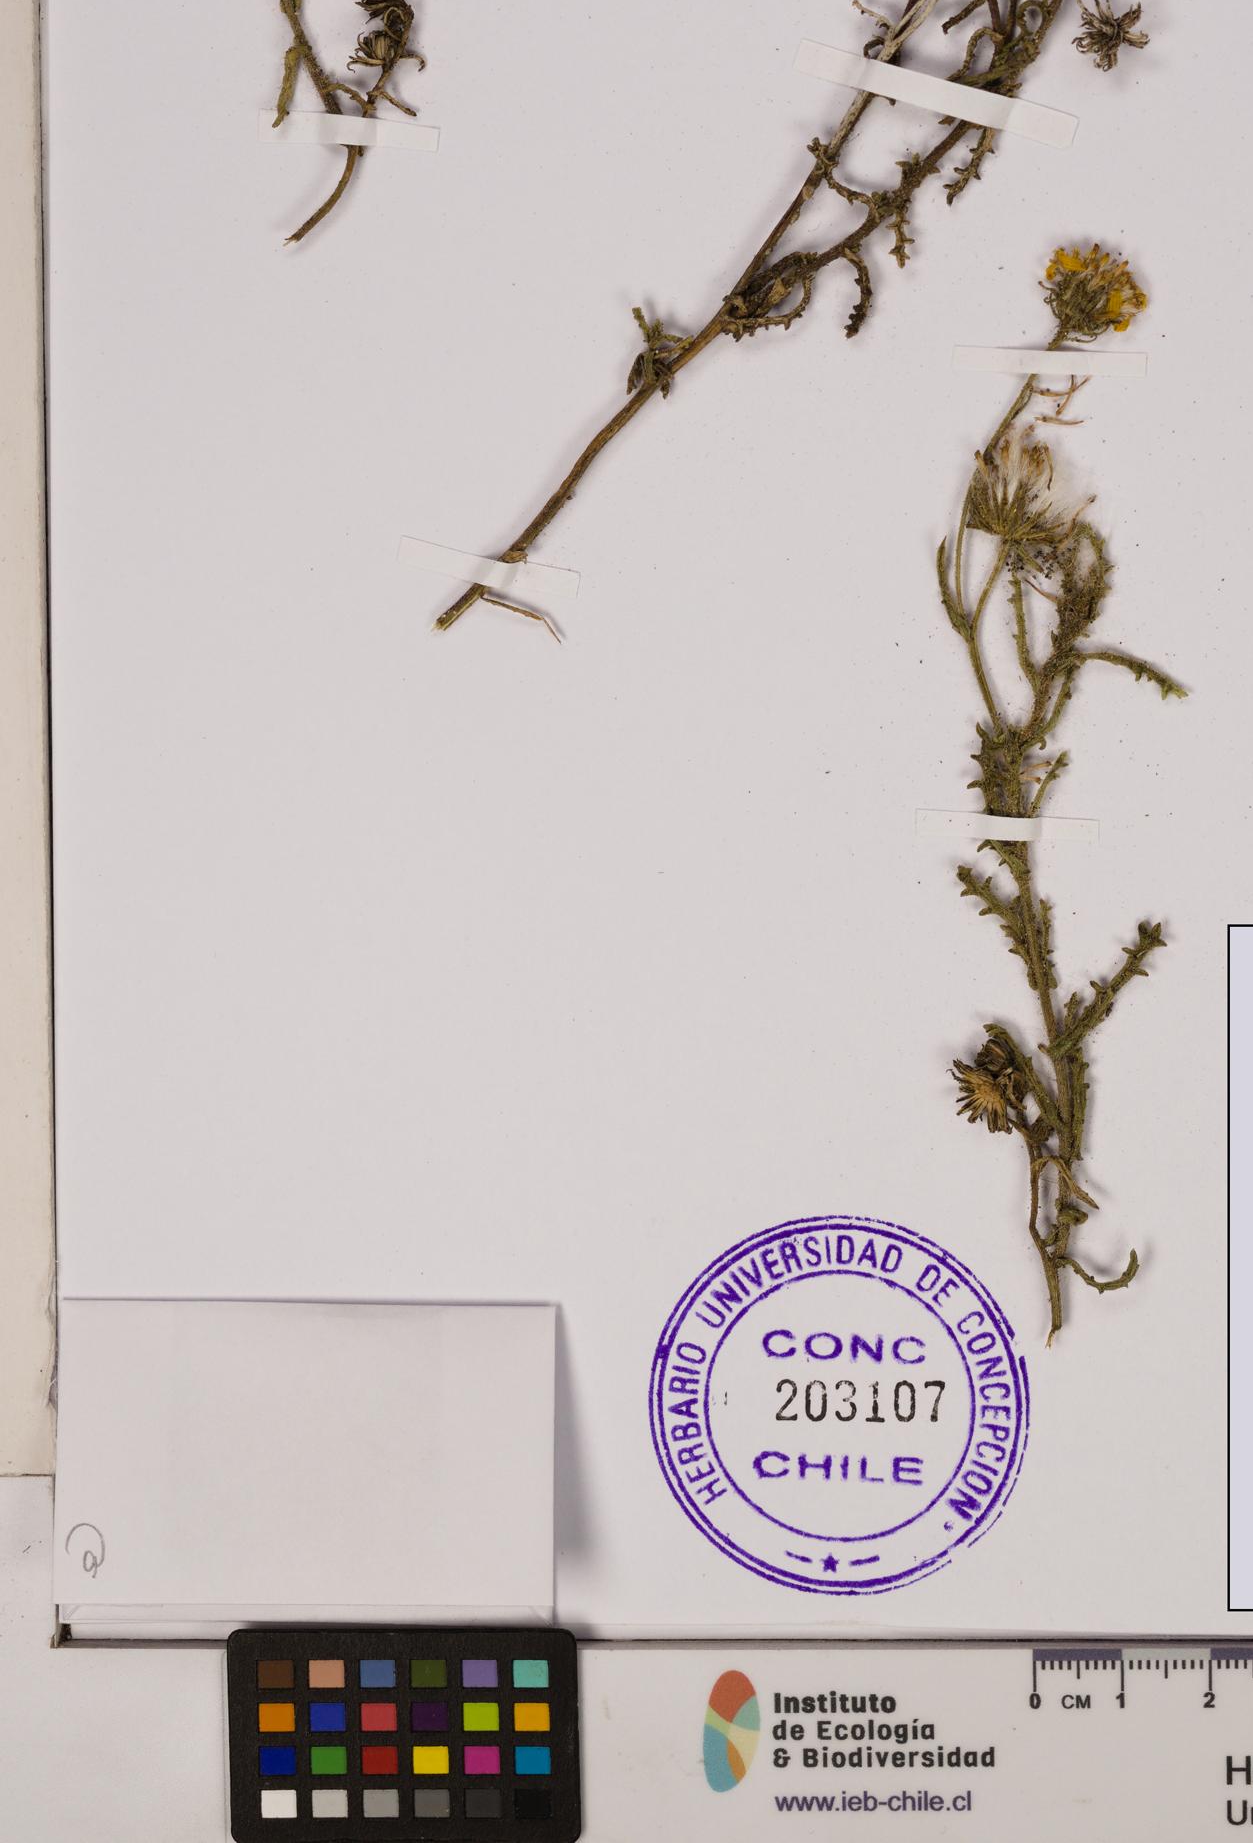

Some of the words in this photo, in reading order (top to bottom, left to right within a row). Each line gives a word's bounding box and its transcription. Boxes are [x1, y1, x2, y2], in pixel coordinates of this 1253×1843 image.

[696, 1235, 904, 1329] UNIVERSIDAD
[915, 1264, 960, 1309] DE
[762, 1329, 926, 1364] CONC
[775, 1378, 946, 1423] 203107
[945, 1309, 1012, 1526] CONCEPCION
[668, 1341, 728, 1506] HERBARIO
[752, 1450, 924, 1485] CHILE
[774, 1690, 897, 1714] Instituto
[1029, 1692, 1042, 1710] 0
[1061, 1693, 1092, 1710] CM
[1115, 1691, 1125, 1709] 1
[1203, 1691, 1216, 1709] 2
[772, 1719, 805, 1741] de
[816, 1718, 935, 1745] Ecología
[773, 1747, 791, 1768] &
[802, 1745, 996, 1769] Biodiversidad
[774, 1790, 972, 1812] www.ieb-chile.cl
